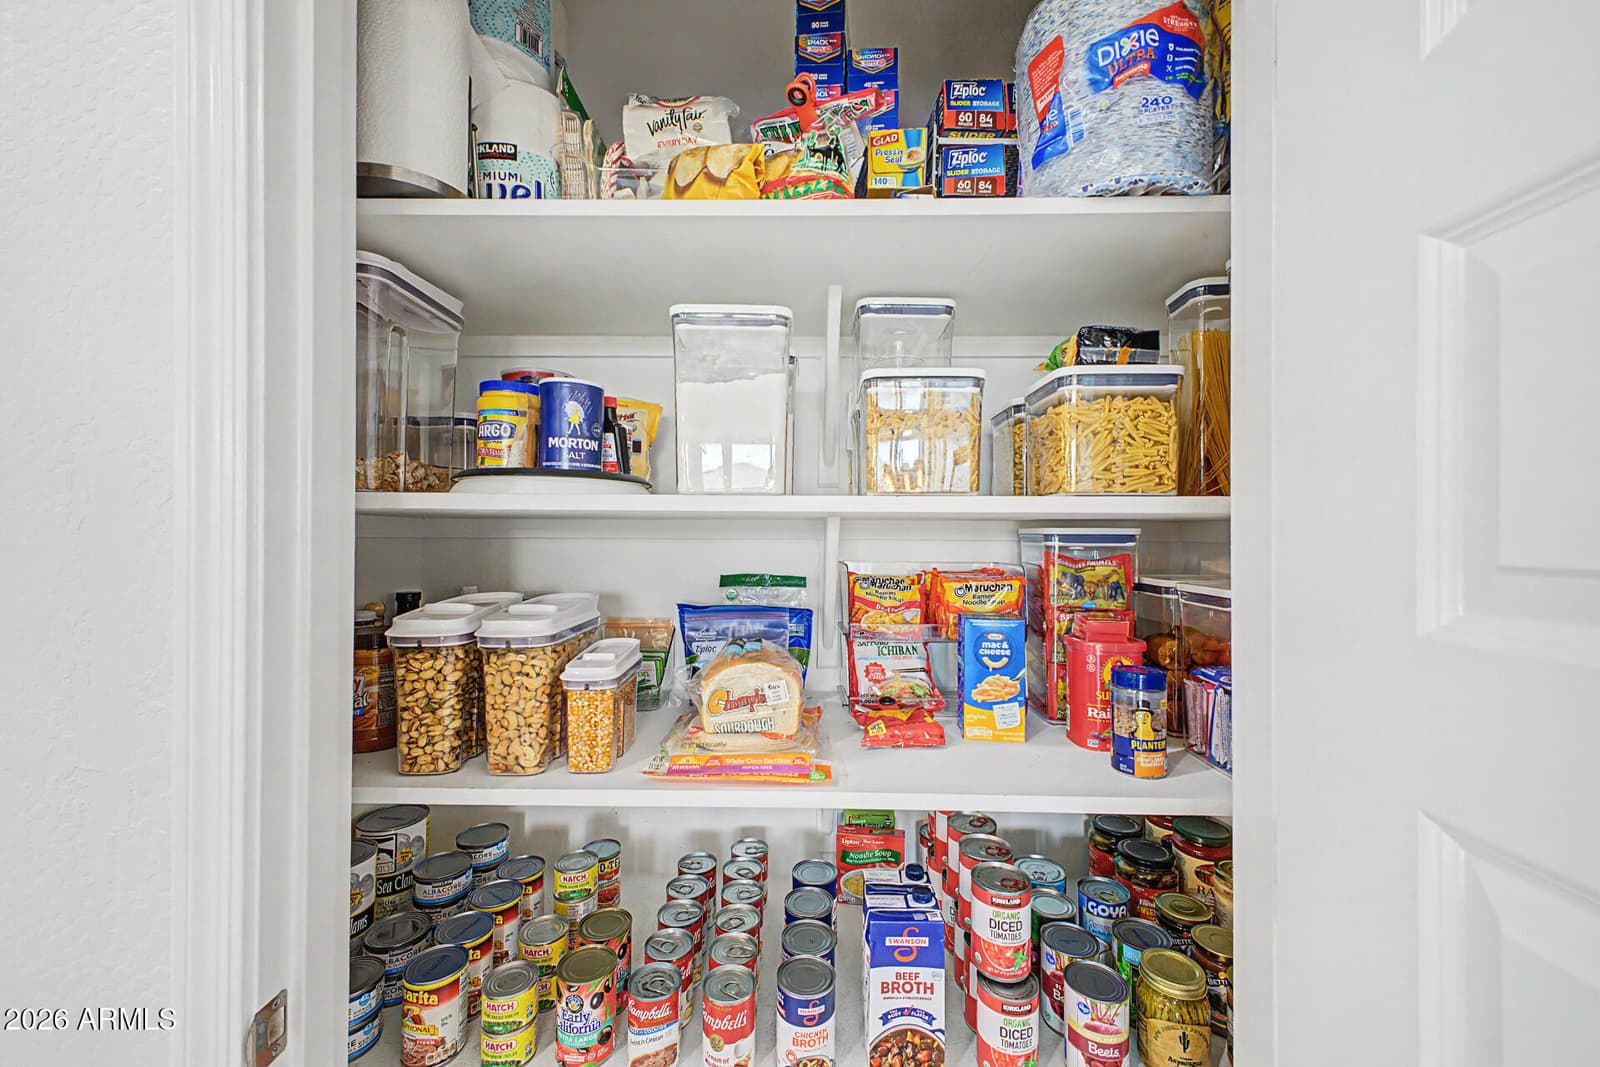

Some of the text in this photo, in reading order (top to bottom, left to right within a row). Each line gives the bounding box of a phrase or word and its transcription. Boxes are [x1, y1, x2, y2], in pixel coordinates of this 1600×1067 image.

[1106, 46, 1158, 77] ULTRA
[953, 84, 987, 99] Ziploc
[1141, 95, 1173, 108] 240
[647, 106, 708, 136] Vanity Fair
[958, 112, 993, 124] 60 84
[872, 133, 898, 146] GLAD
[479, 143, 515, 154] KLAND
[885, 156, 902, 164] Seal
[951, 152, 988, 168] Ziploc
[957, 180, 992, 190] 60 84
[478, 423, 511, 439] ARGO
[548, 437, 599, 451] MORTON
[562, 451, 586, 460] SALT
[964, 583, 1013, 593] Maruchan
[878, 645, 919, 656] ICHIBAN
[714, 718, 775, 734] SOURDOUGH
[1131, 740, 1167, 750] PLANTER
[841, 838, 860, 846] Lipton
[849, 849, 892, 859] Noodle Soup
[376, 872, 414, 895] Sea Clam
[562, 873, 587, 882] HATCH
[992, 910, 1021, 920] ORGANIC
[1087, 901, 1127, 918] GOYA
[989, 918, 1023, 932] DICED
[990, 931, 1022, 941] TOMATOES
[523, 948, 549, 957] HATCH
[895, 971, 920, 980] BEEF
[880, 981, 935, 995] BROTH
[403, 989, 439, 1005] arita
[486, 1002, 515, 1012] HATCH
[562, 1008, 590, 1023] Early
[703, 1009, 747, 1031] mpbell's
[558, 1020, 601, 1034] alifornia
[1003, 1017, 1031, 1028] ORGANIC
[794, 1027, 827, 1039] CHICKEN
[1000, 1026, 1033, 1040] DICED
[484, 1041, 513, 1051] HATCH
[792, 1032, 829, 1048] BROTH
[1000, 1039, 1033, 1049] TOMATOES
[1087, 1041, 1120, 1057] Beets
